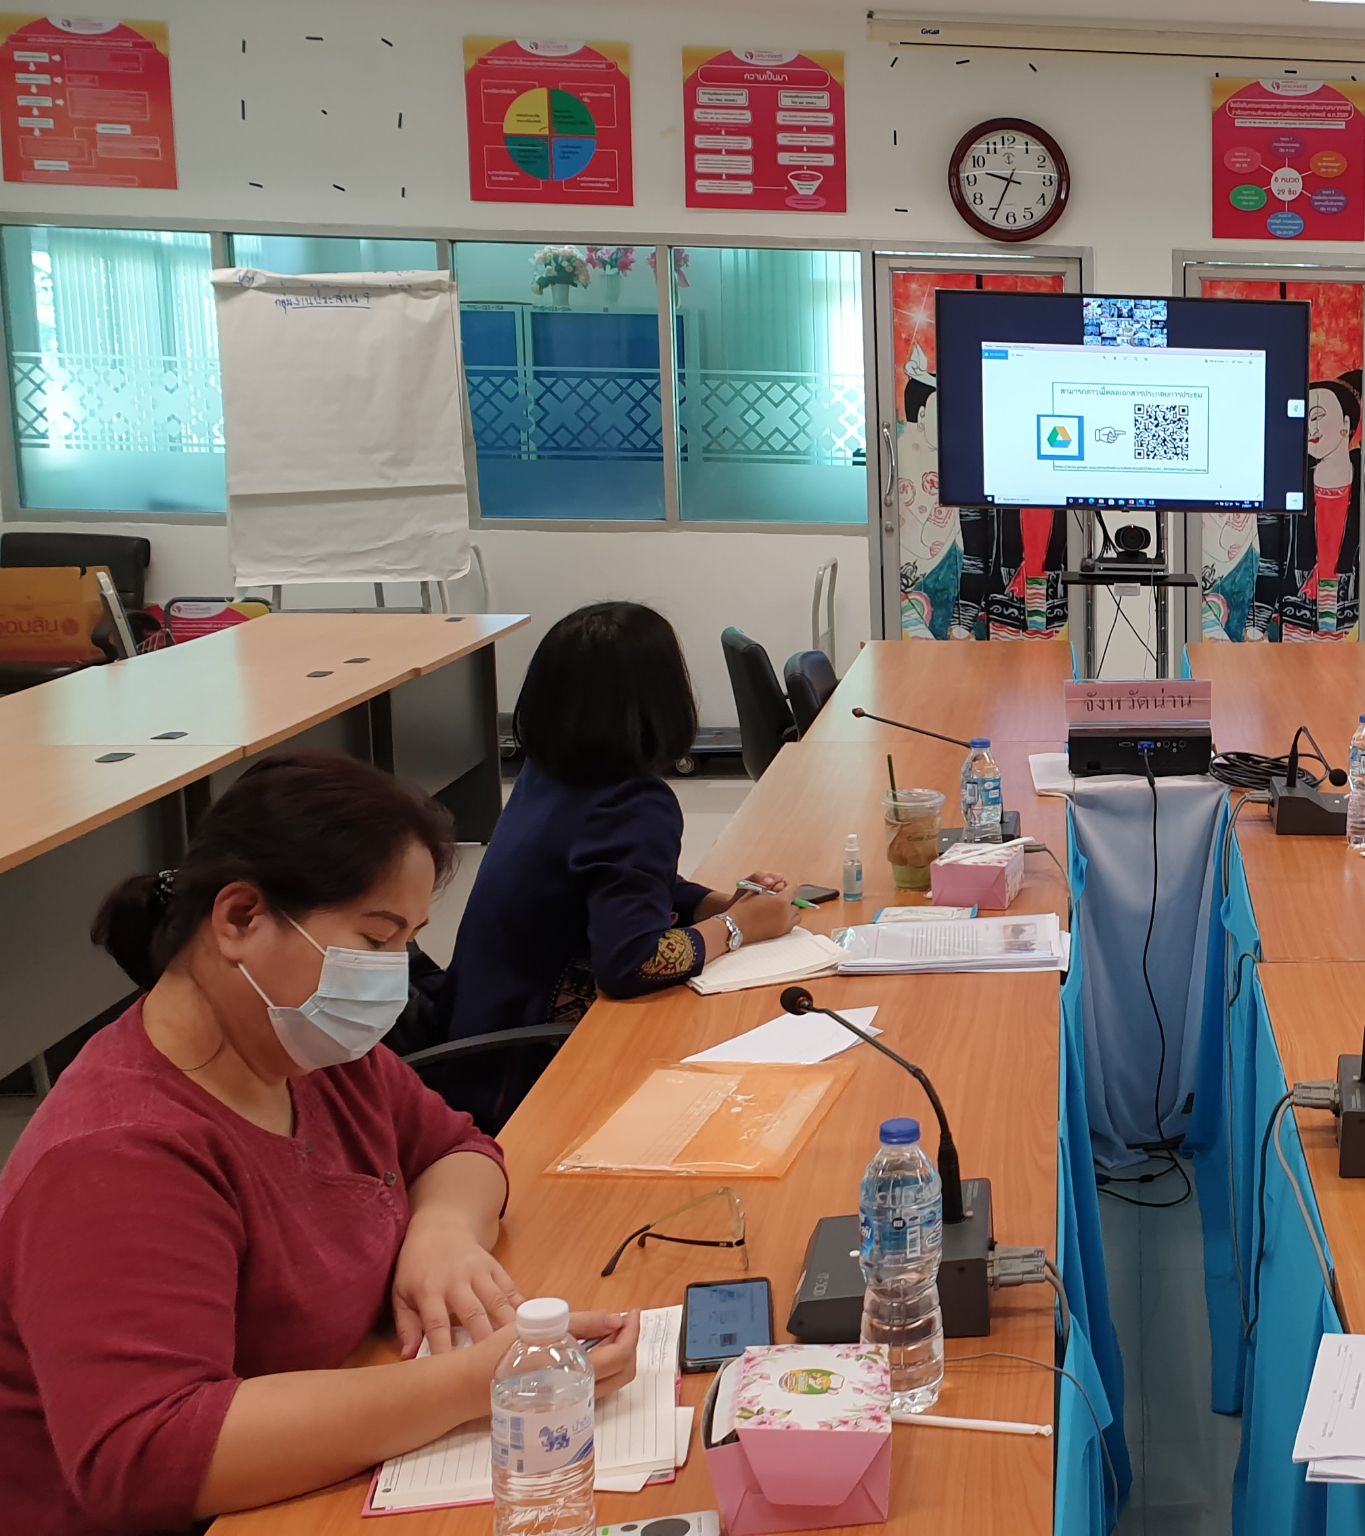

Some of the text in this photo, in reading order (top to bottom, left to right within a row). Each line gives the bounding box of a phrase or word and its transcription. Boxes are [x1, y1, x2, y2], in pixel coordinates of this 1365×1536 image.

[743, 70, 788, 82] ความเป็นมา
[986, 141, 998, 155] 11
[1001, 135, 1016, 149] 12
[1023, 141, 1030, 155] 1
[972, 155, 986, 168] 10
[1036, 155, 1046, 168] 2
[966, 174, 978, 187] 9
[1042, 174, 1053, 187] 3
[973, 191, 984, 205] 8
[1036, 193, 1046, 206] 4
[989, 207, 998, 220] 7
[1005, 211, 1017, 225] 6
[1023, 207, 1034, 220] 5
[1084, 687, 1192, 712] จังหวัดน่าน
